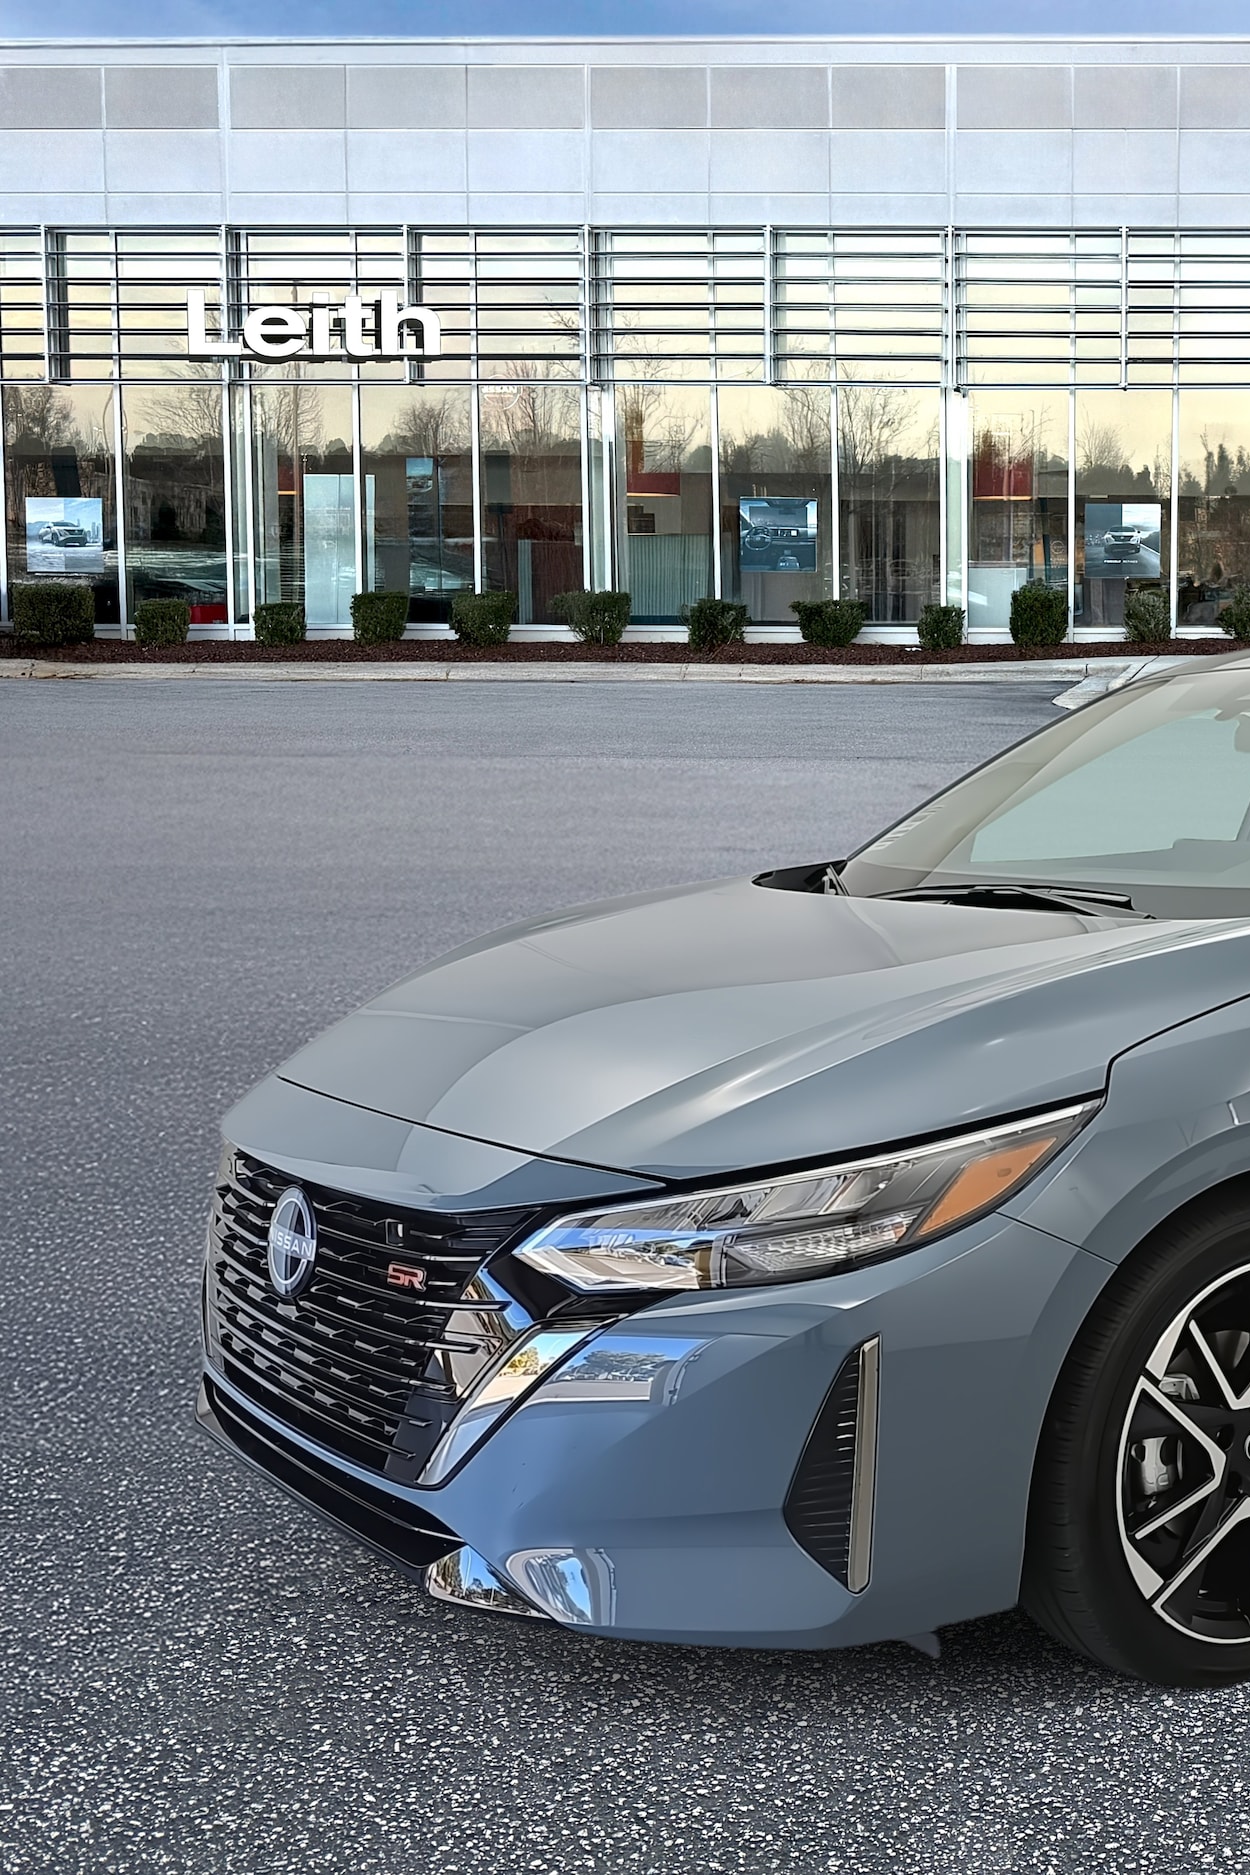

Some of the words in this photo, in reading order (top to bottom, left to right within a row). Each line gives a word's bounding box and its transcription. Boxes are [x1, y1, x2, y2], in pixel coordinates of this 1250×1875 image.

[187, 289, 442, 358] Leith
[270, 1225, 314, 1259] NISSAN
[387, 1263, 427, 1292] SR
